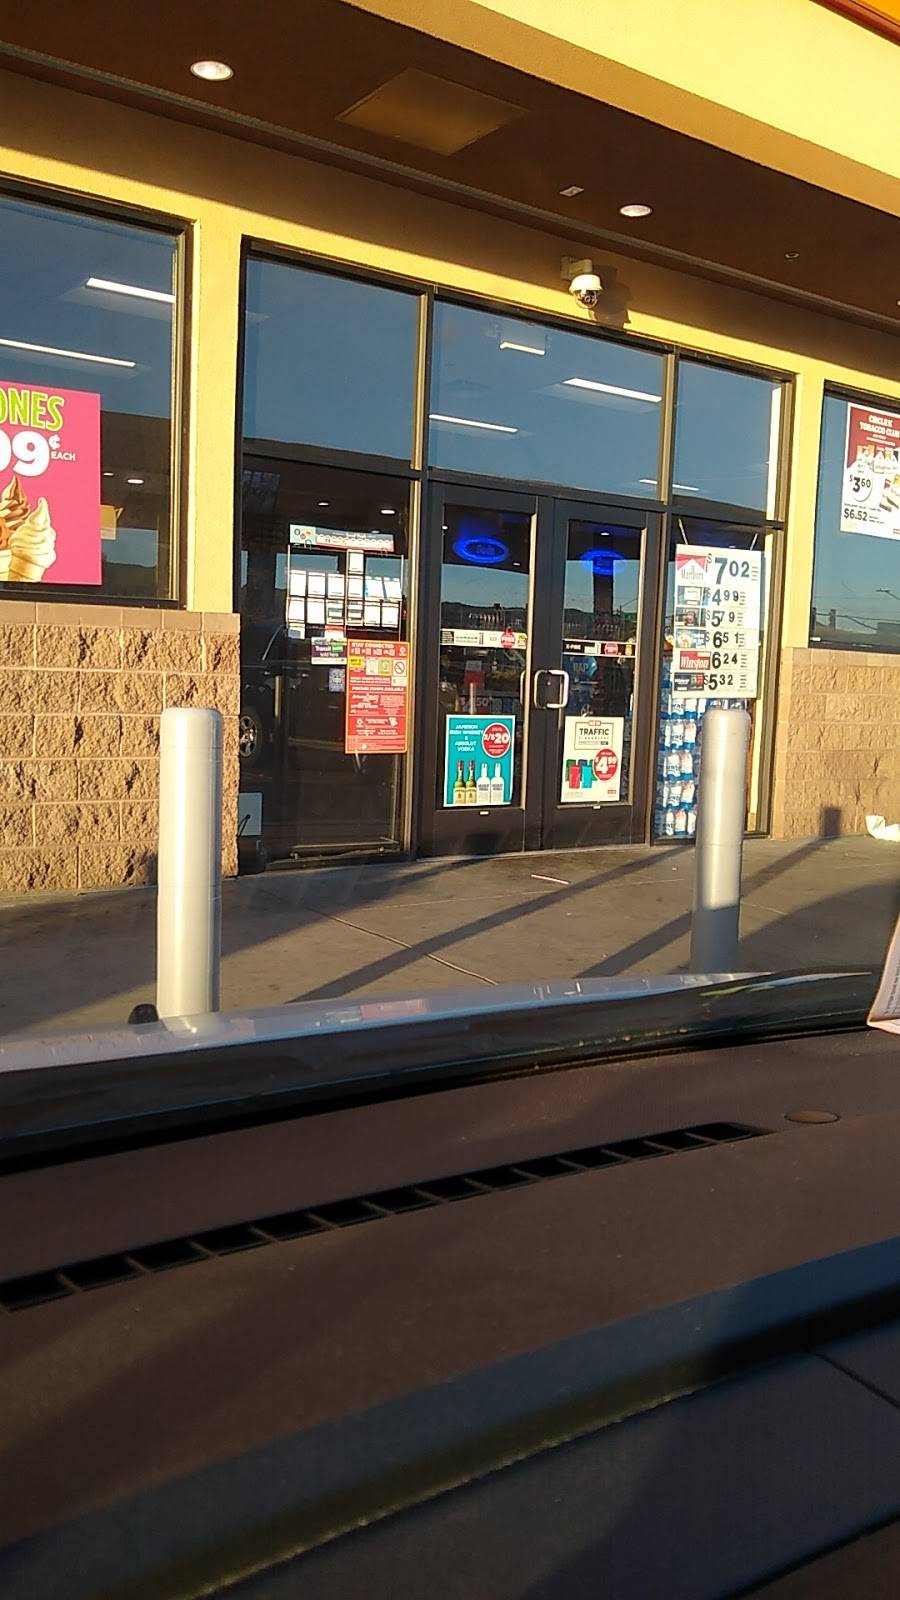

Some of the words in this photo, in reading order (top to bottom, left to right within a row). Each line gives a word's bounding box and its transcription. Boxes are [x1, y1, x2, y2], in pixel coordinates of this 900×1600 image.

[51, 451, 76, 461] EACH
[844, 508, 868, 521] $6.52
[680, 656, 709, 669] Winston
[579, 728, 610, 736] TRAFFIC
